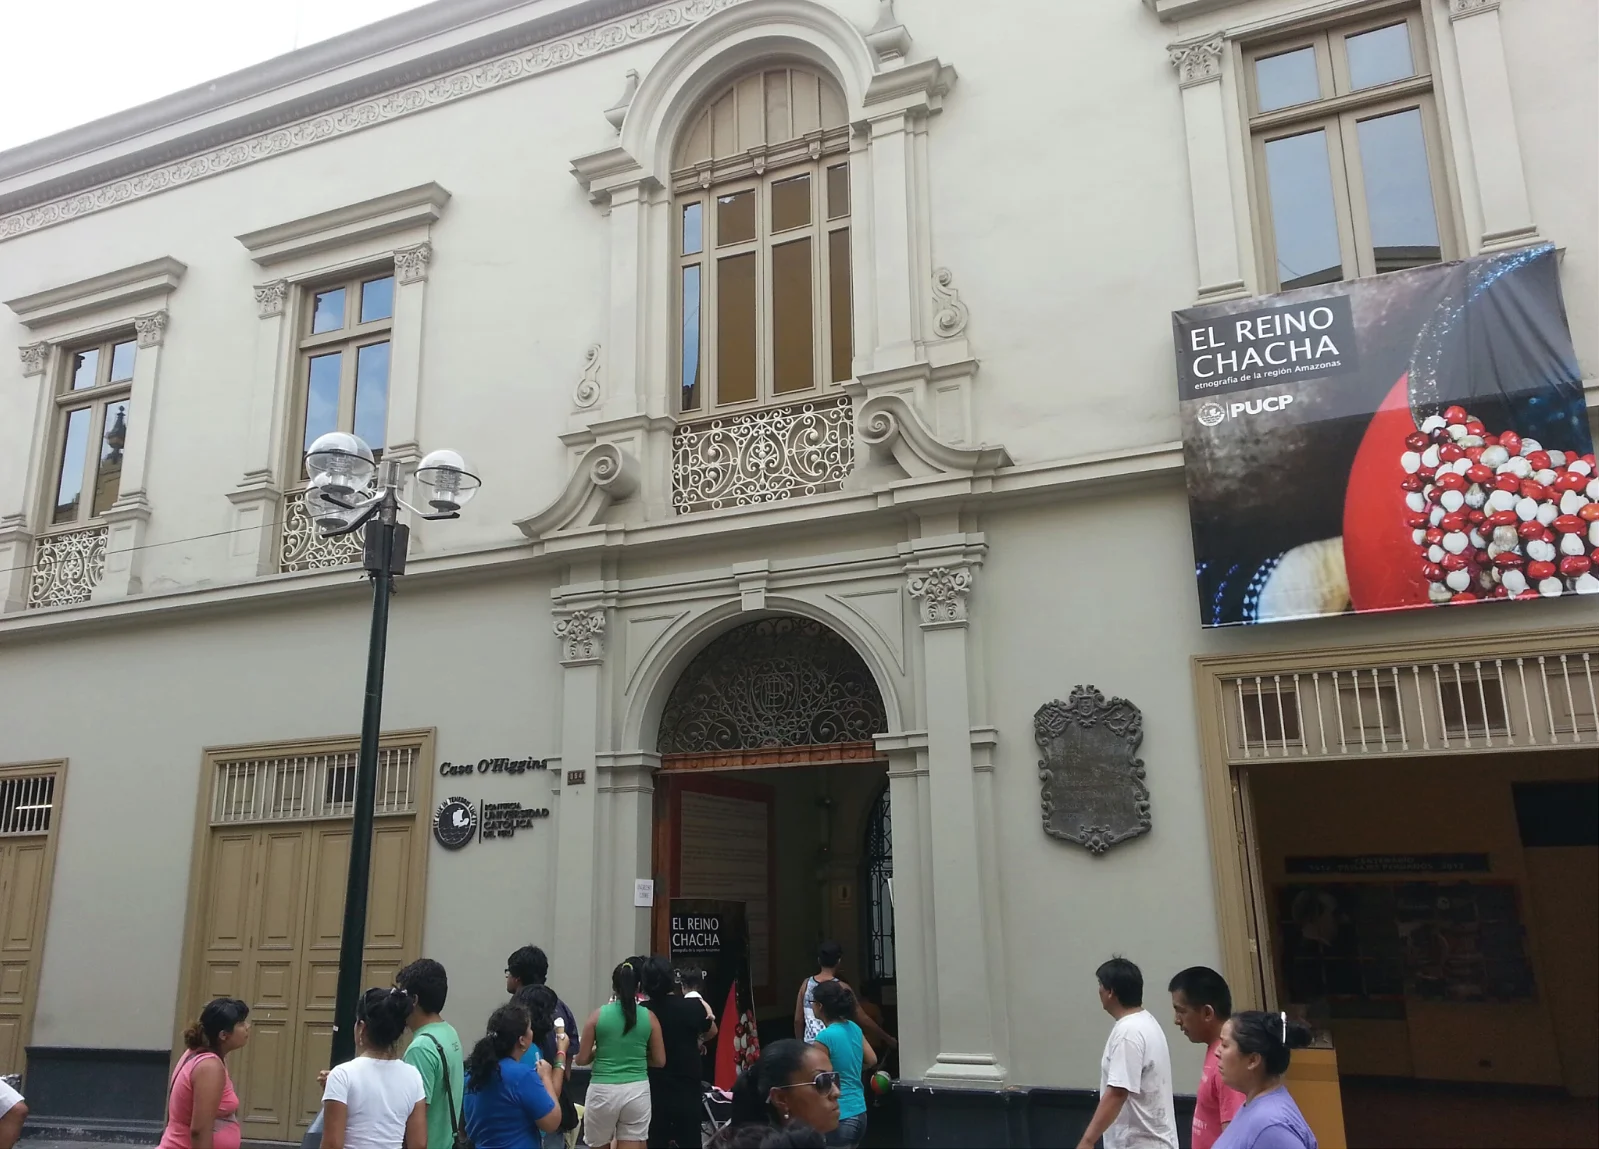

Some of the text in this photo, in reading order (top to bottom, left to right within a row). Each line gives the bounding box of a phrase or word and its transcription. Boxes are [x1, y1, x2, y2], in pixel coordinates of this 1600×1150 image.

[1190, 306, 1334, 351] EL REINO
[1192, 335, 1340, 378] CHACHA
[1240, 374, 1252, 382] de
[1253, 371, 1262, 379] la
[1264, 367, 1292, 379] región
[1294, 359, 1342, 373] Amazonas
[1230, 394, 1294, 418] PUCP
[439, 756, 548, 775] Casa O'Higgins
[672, 917, 719, 930] EL REINO
[672, 933, 720, 947] CHACHA
